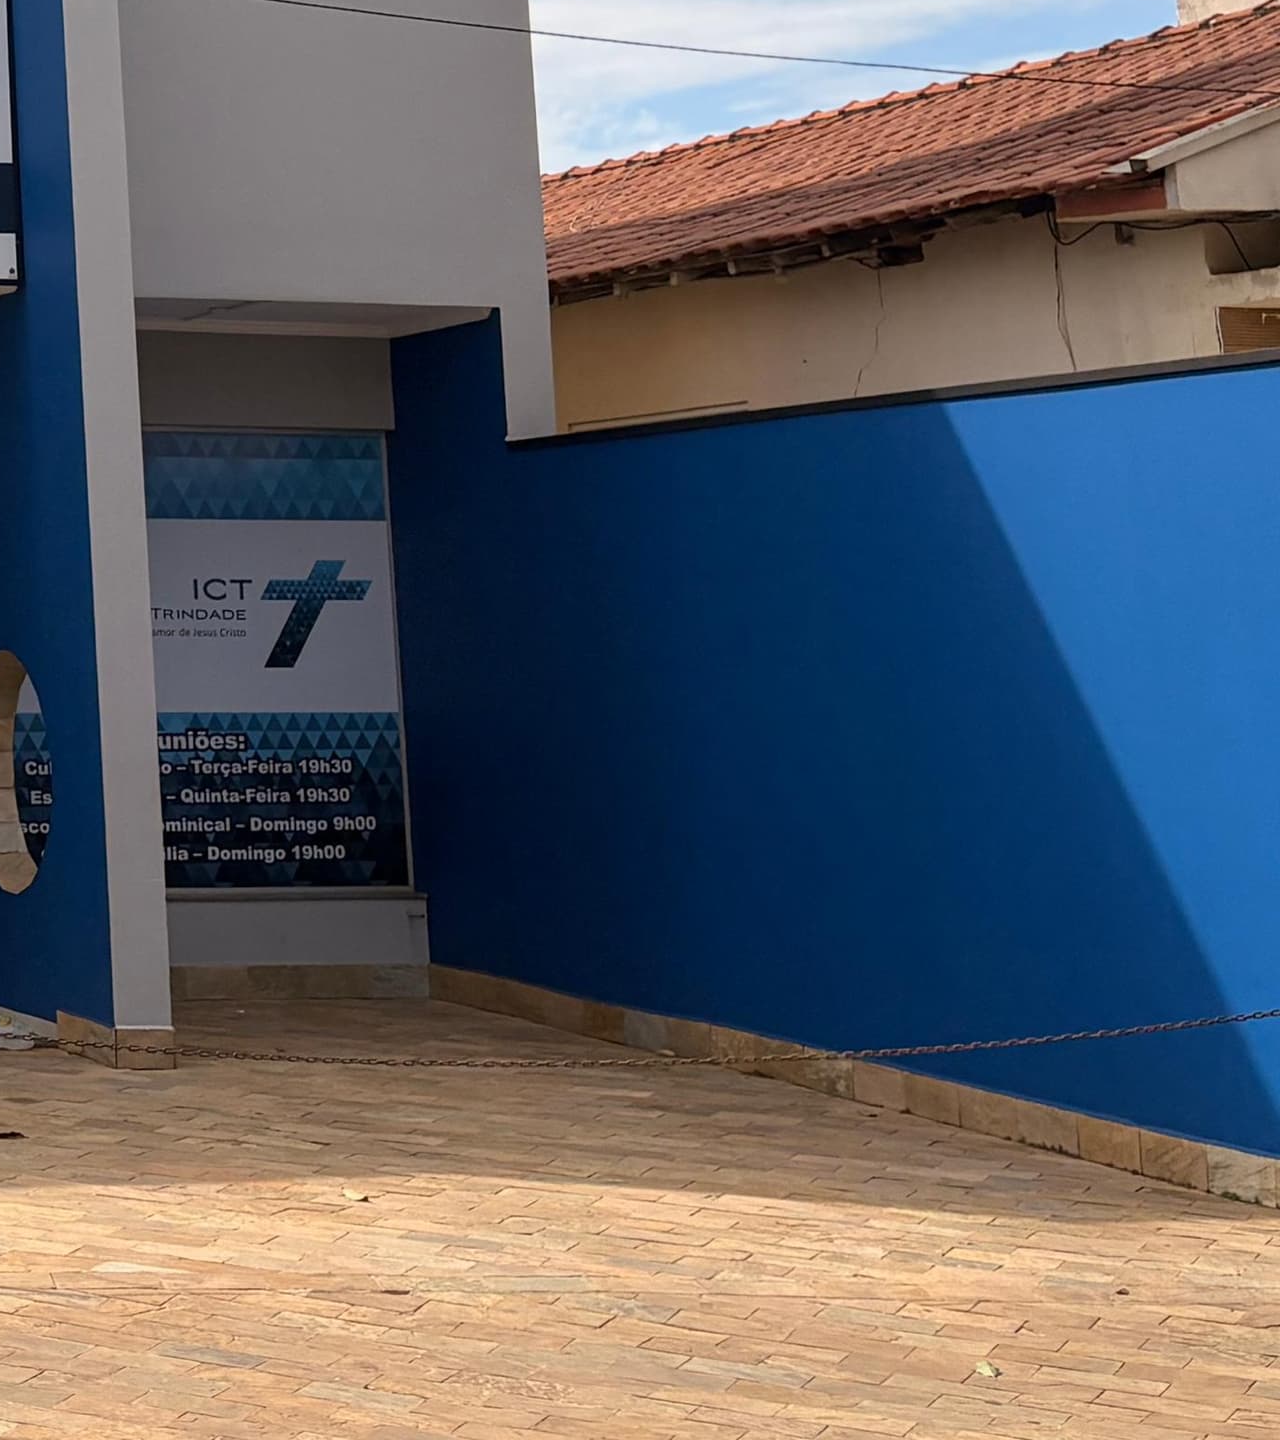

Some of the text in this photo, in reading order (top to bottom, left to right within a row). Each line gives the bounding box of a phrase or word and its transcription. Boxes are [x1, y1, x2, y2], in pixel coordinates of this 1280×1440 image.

[193, 578, 252, 601] ICT
[151, 608, 247, 621] TRINDADE
[179, 627, 190, 637] de
[193, 628, 217, 637] Jesus
[220, 627, 247, 637] Cristo
[191, 759, 293, 777] Terça-Feira
[298, 759, 352, 774] 19h30
[180, 788, 291, 804] Quinta-Feira
[296, 788, 350, 803] 19h30
[162, 817, 231, 832] minical
[250, 816, 328, 834] Domingo
[333, 816, 377, 831] 9h00
[163, 846, 189, 860] lia
[207, 845, 286, 863] Domingo
[291, 845, 346, 860] 19h00
